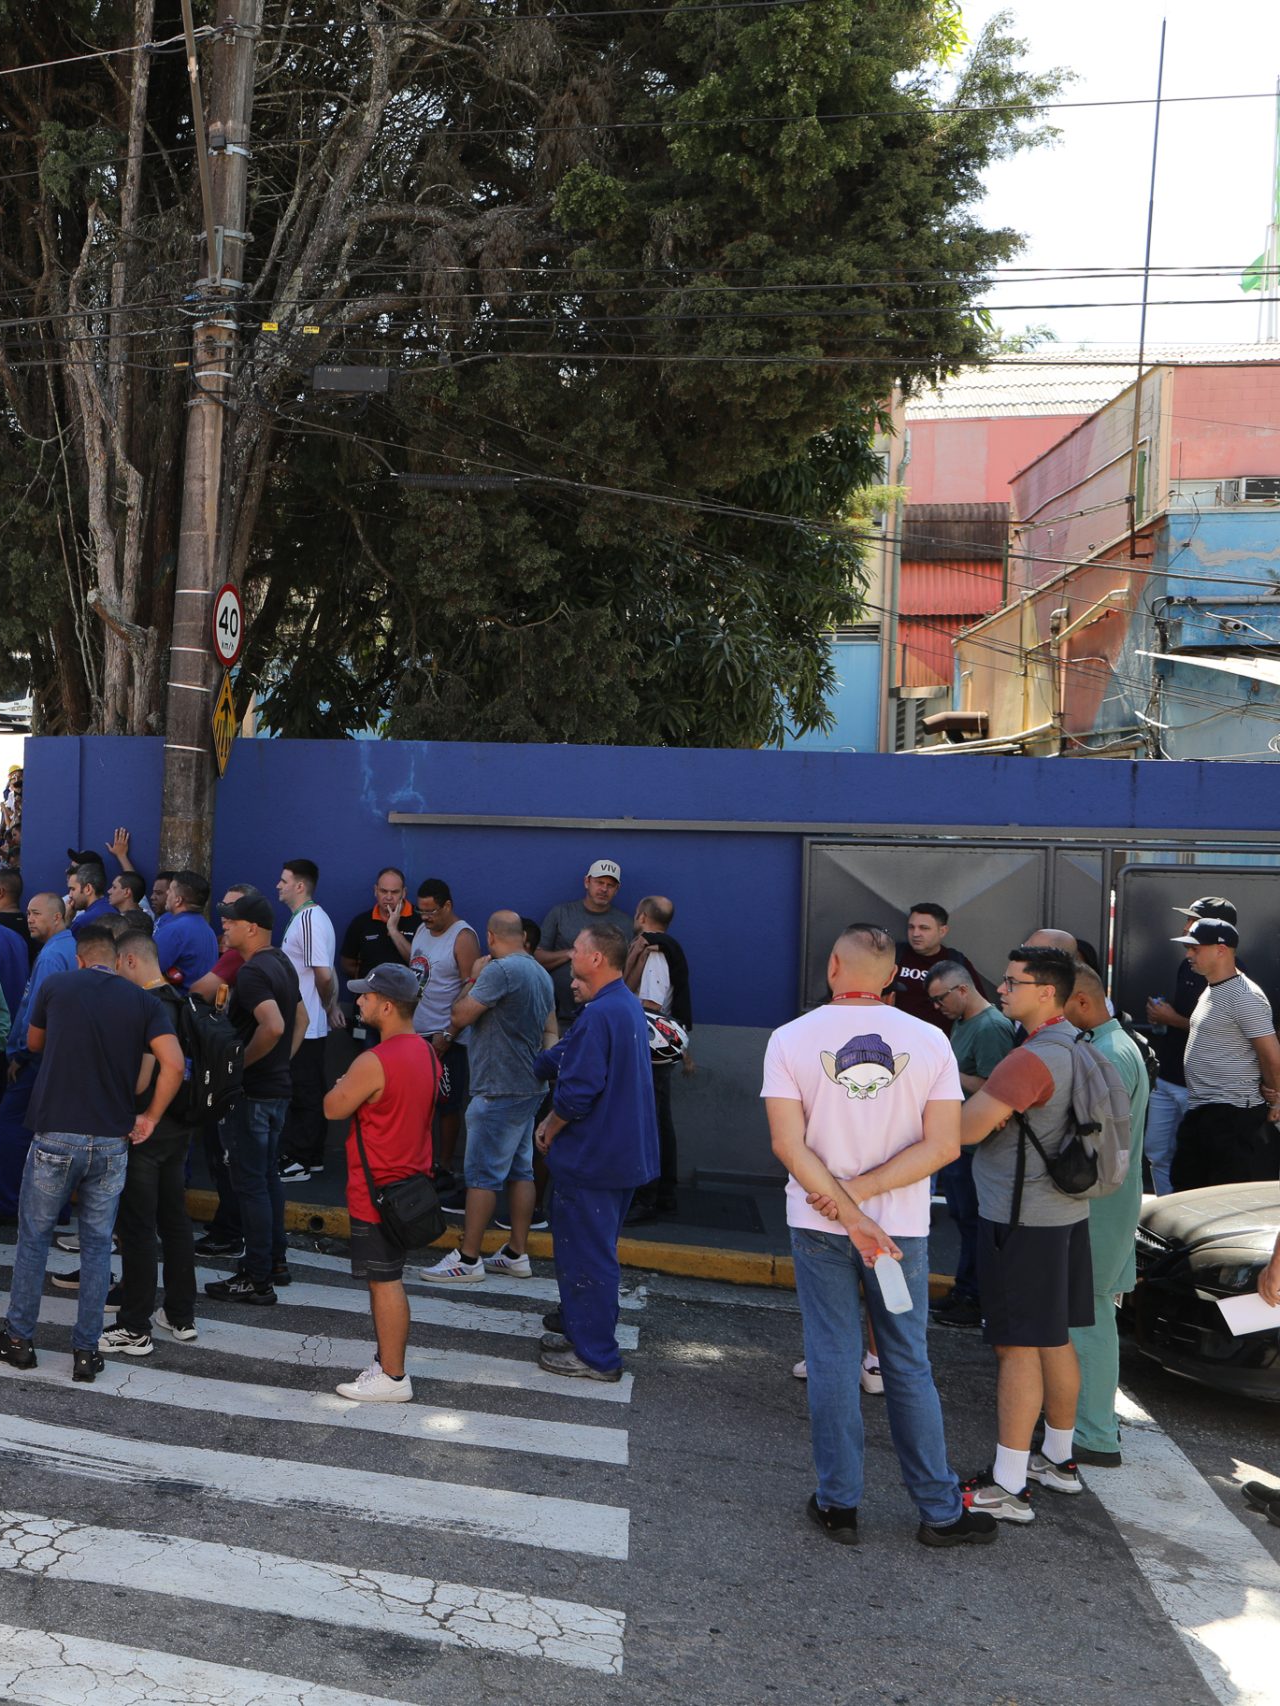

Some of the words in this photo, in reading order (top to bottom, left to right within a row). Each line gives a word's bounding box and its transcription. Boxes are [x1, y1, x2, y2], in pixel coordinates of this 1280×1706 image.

[219, 606, 239, 638] 40
[900, 967, 929, 982] BOS
[229, 1283, 256, 1293] FILA
